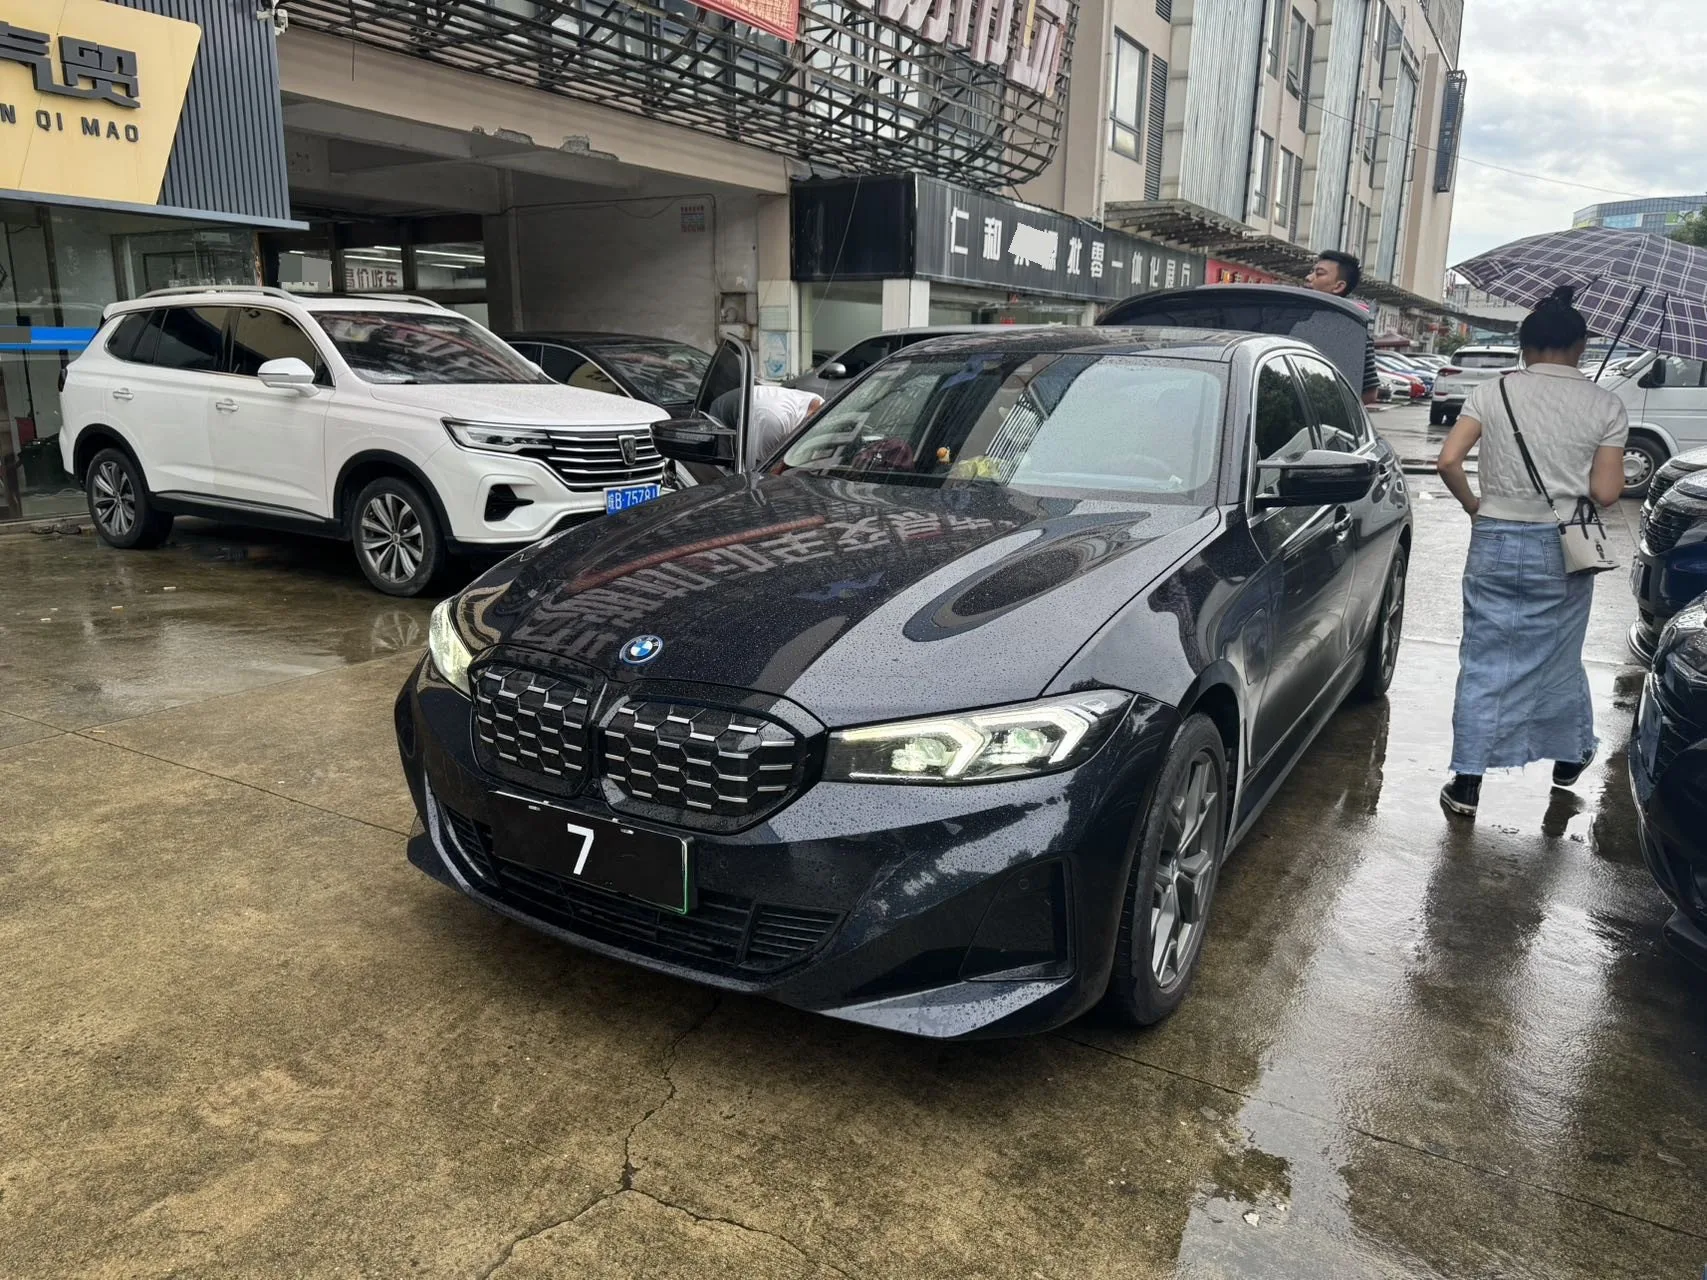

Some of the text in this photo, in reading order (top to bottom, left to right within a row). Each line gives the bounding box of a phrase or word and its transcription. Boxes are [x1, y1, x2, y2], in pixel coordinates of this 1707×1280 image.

[36, 109, 64, 132] QI
[81, 116, 139, 143] MAO
[567, 823, 594, 875] 7
